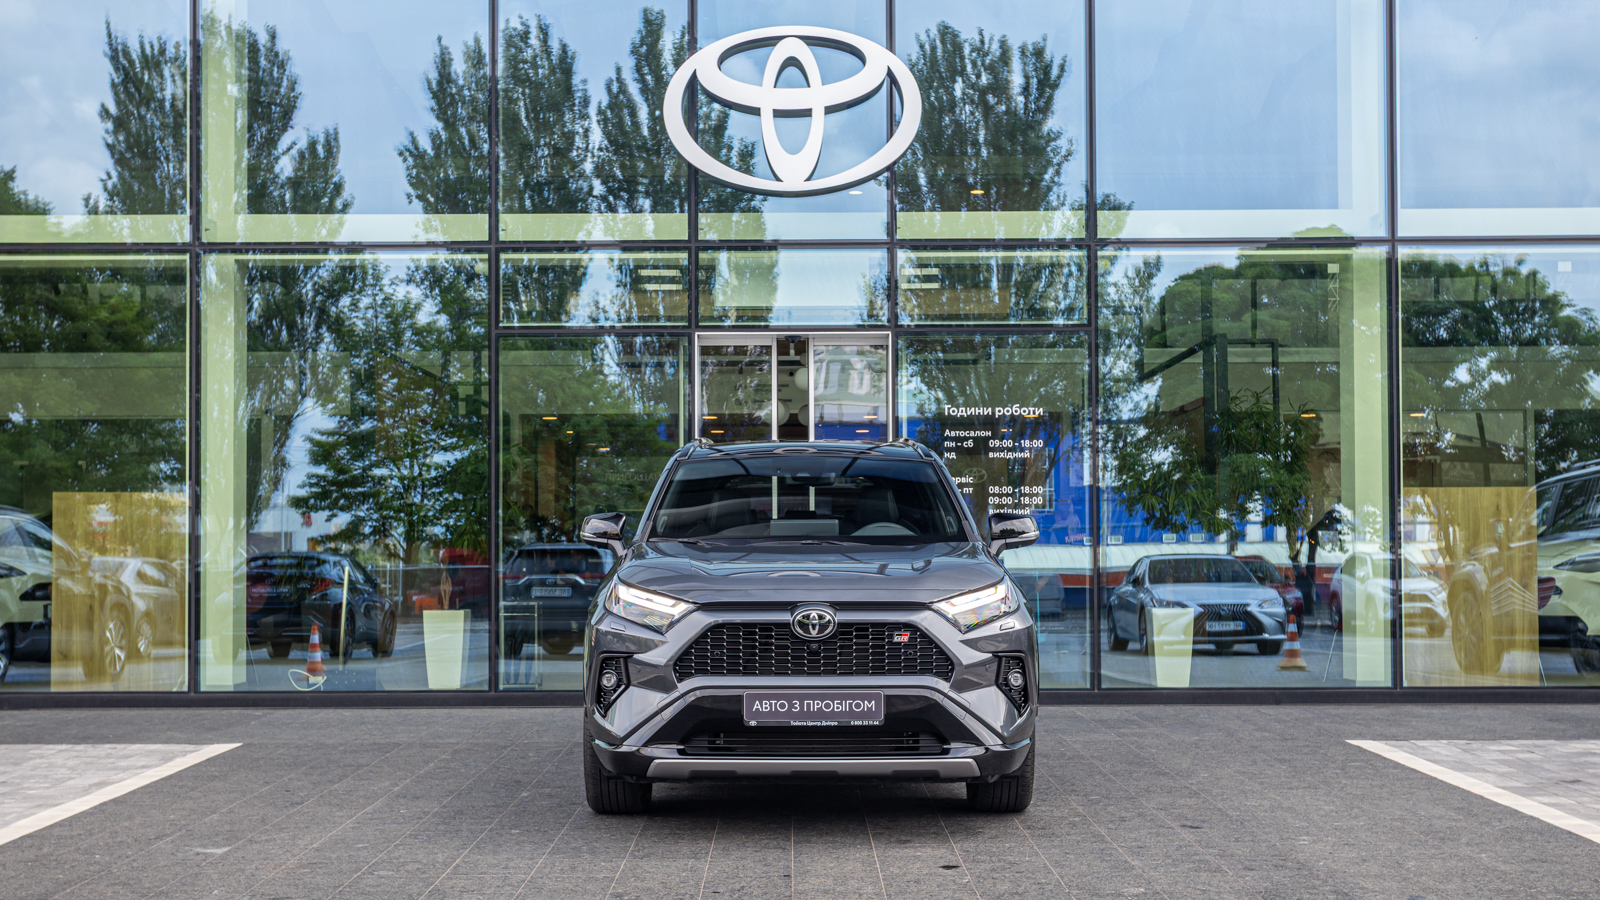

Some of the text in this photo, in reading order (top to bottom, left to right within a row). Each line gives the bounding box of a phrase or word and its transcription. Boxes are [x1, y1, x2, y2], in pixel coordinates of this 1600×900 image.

[944, 404, 1044, 418] Години роботи
[944, 429, 992, 437] Автосалон
[963, 440, 974, 448] сб
[989, 440, 1013, 448] 09:00
[1020, 440, 1044, 448] 18:00
[989, 450, 1030, 459] вихідний
[952, 475, 974, 484] ервіс
[988, 486, 1013, 494] 08:00
[1020, 486, 1043, 494] 18:00
[988, 497, 1013, 505] 09:00
[1020, 497, 1043, 505] 18:00
[752, 700, 789, 712] АВТО
[804, 700, 876, 712] ПРОБІГОМ
